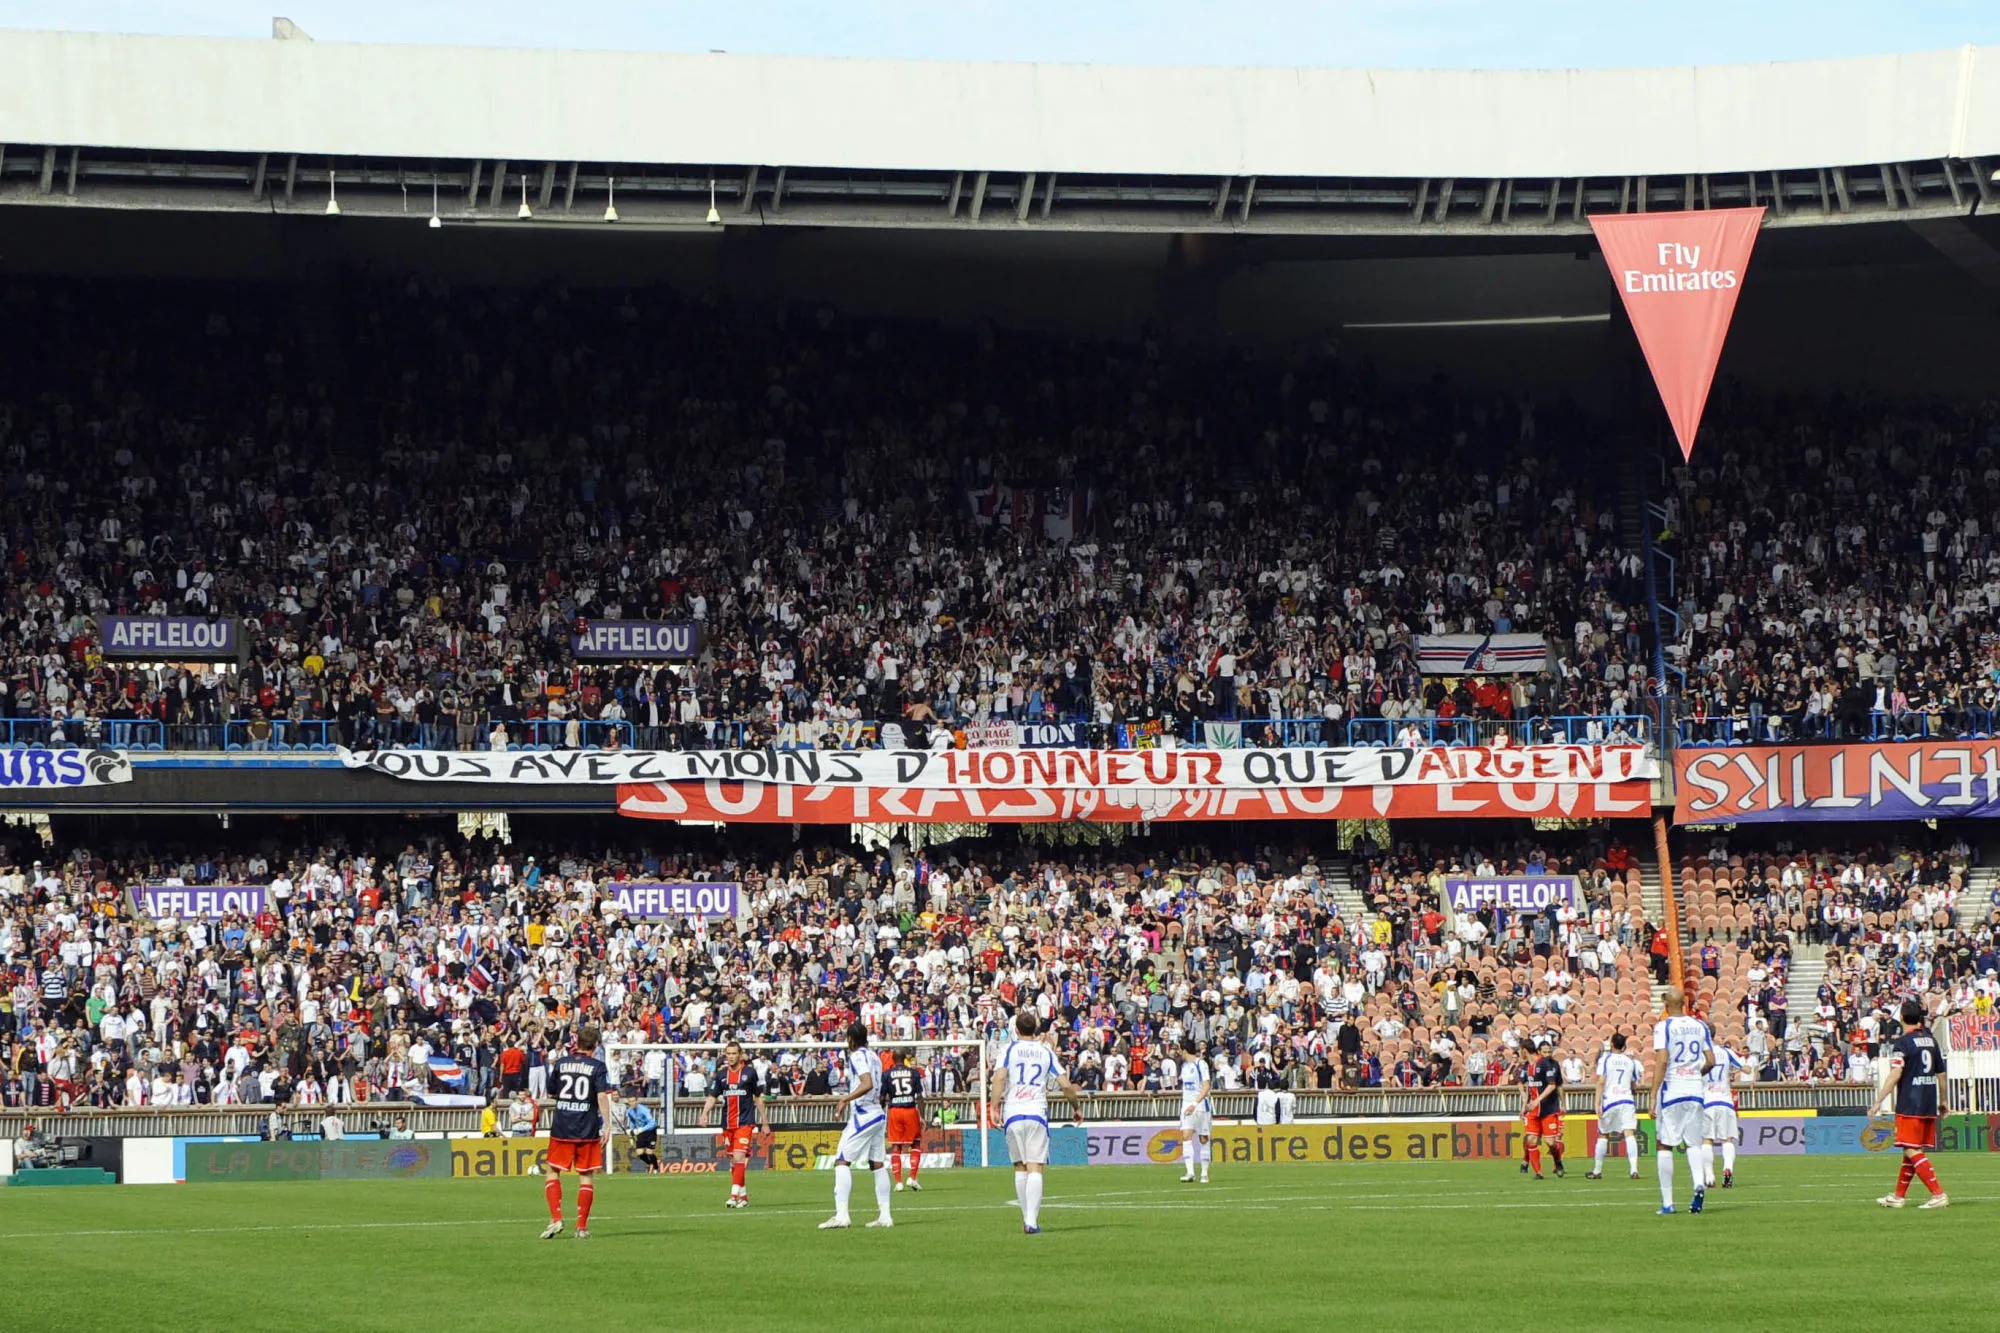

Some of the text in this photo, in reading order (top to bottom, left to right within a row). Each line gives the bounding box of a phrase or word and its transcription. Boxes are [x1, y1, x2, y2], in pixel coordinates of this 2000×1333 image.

[1657, 243, 1700, 268] Fly
[1624, 268, 1737, 292] Emirates
[111, 622, 226, 647] AFFLELOU
[578, 627, 689, 651] AFFLELOU
[967, 728, 1013, 740] CORAGE
[510, 752, 666, 780] AVEZ
[680, 750, 863, 783] MOINS
[890, 750, 1225, 786] D'HONNEUR
[1243, 751, 1356, 784] QUE
[1376, 745, 1644, 780] D'ARGENT
[146, 892, 258, 917] AFFLELOU
[617, 888, 730, 913] AFFLELOU
[1453, 884, 1566, 908] AFFLELOU
[1674, 1041, 1700, 1062] 29
[1921, 1049, 1932, 1073] 9
[892, 1078, 912, 1095] 15
[1016, 1063, 1042, 1086] 12
[1616, 1069, 1624, 1084] 7
[559, 1075, 590, 1100] 20
[1323, 1125, 1392, 1160] des
